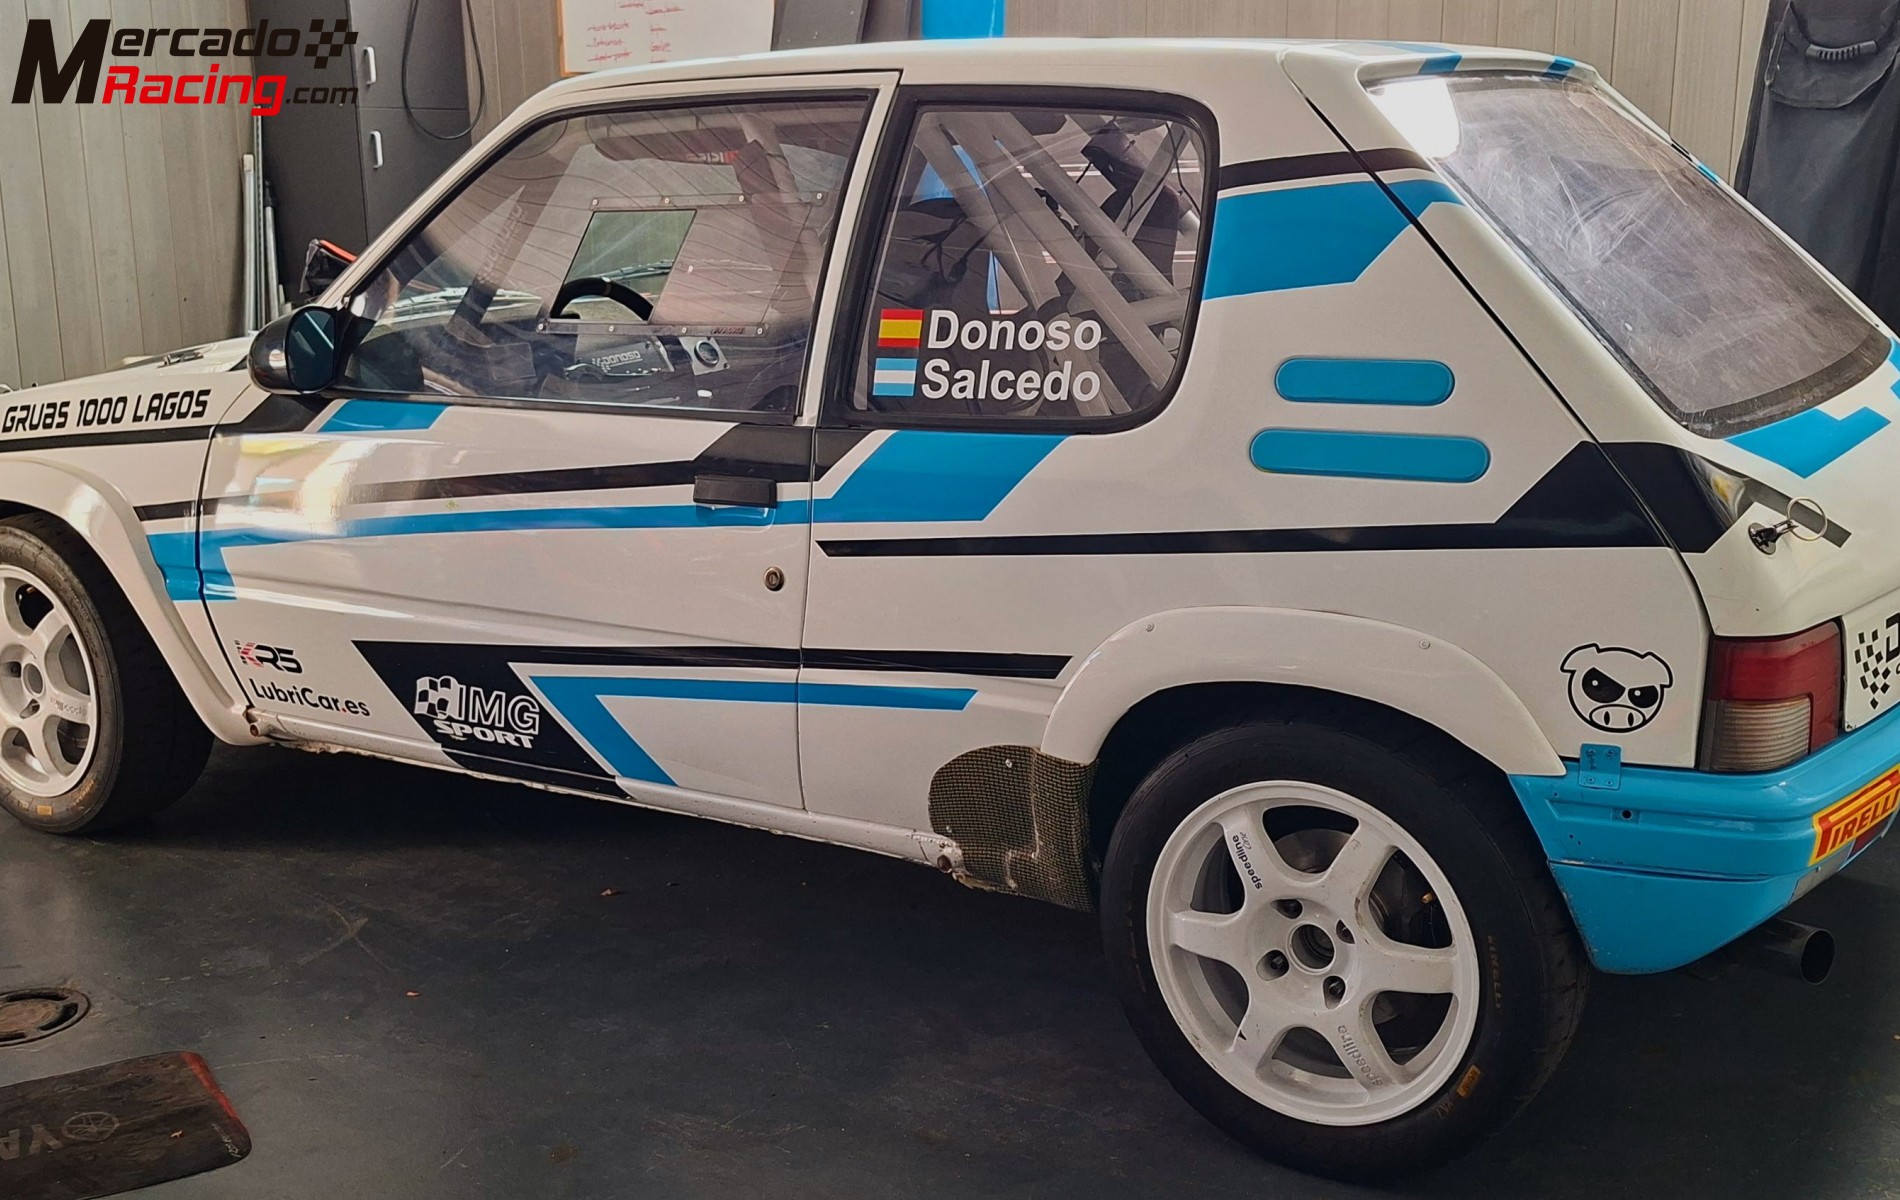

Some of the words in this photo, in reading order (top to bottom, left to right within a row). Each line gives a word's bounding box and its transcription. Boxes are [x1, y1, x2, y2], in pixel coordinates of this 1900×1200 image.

[927, 309, 1102, 351] Donoso
[921, 358, 1101, 402] Salcedo
[76, 396, 128, 427] 1000
[131, 389, 212, 423] LAGOS
[248, 677, 371, 717] LubriCar.es
[457, 683, 540, 736] IMG
[433, 719, 535, 749] SPORT
[1232, 834, 1263, 890] speedline
[1337, 1024, 1383, 1089] speedline
